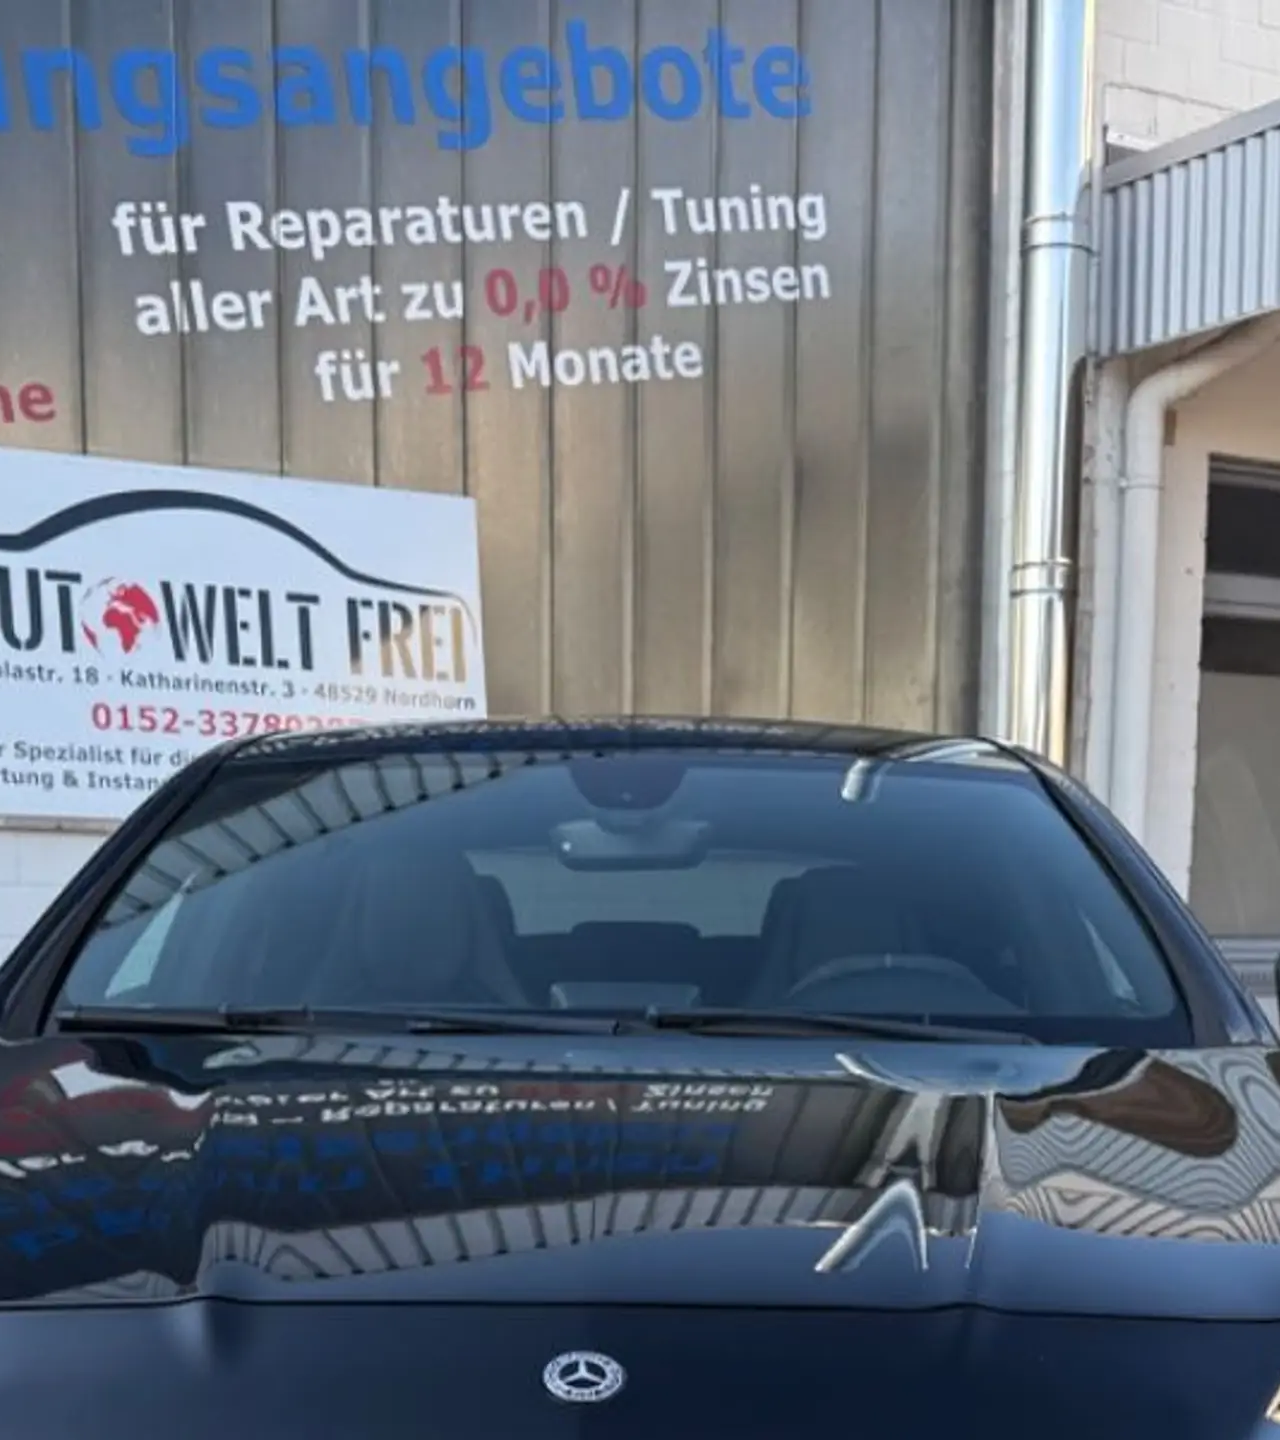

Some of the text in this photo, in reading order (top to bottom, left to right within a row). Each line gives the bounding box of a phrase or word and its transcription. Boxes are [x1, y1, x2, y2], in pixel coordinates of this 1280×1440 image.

[112, 185, 828, 260] für Reparaturen / Tuning
[135, 257, 831, 336] aller Art zu 0,0 % Zinsen
[315, 336, 703, 402] für 12 Monate
[347, 596, 467, 683] FREI
[73, 665, 100, 685] 18
[121, 669, 276, 697] Katharinenstr.
[282, 681, 296, 698] 3
[384, 690, 476, 711] Nordhorn
[14, 740, 124, 764] Spezialist
[131, 747, 162, 766] für
[63, 770, 79, 788] &
